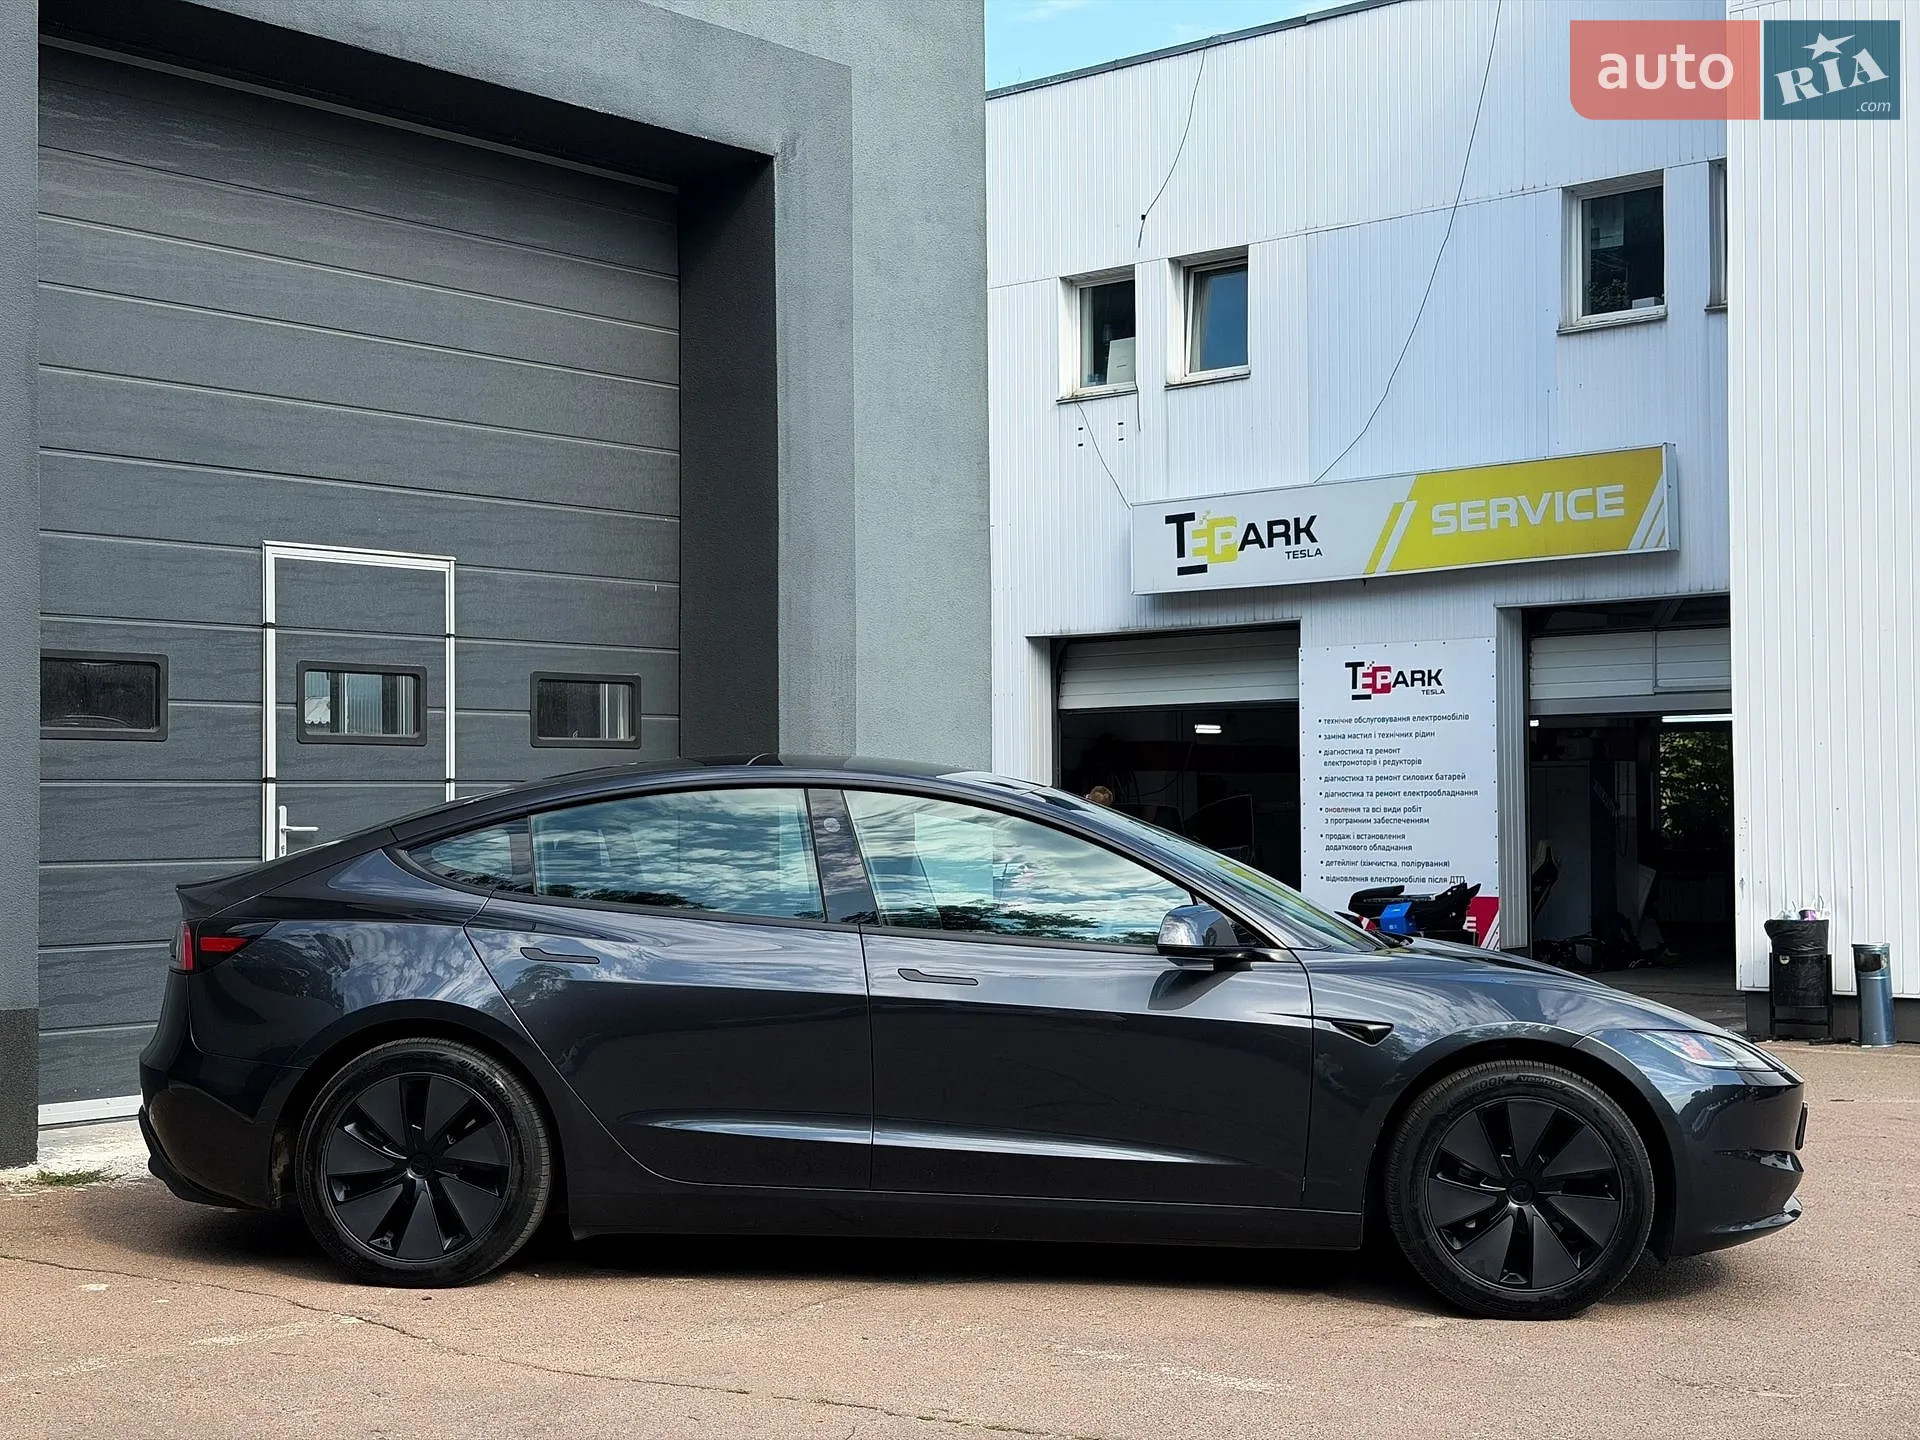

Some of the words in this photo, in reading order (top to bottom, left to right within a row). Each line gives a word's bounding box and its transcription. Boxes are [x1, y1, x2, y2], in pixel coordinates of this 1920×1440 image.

[1431, 484, 1625, 537] SERVICE
[1285, 547, 1323, 561] TESLA
[1354, 715, 1411, 725] обслуговування
[1412, 713, 1470, 723] електромобілів
[1415, 731, 1435, 739] рідин
[1324, 749, 1363, 757] діагностика
[1375, 748, 1400, 756] ремонт
[1324, 758, 1377, 767] електромоторів
[1382, 757, 1422, 766] редукторів
[1324, 775, 1363, 783] діагностика
[1375, 774, 1401, 783] ремонт
[1435, 772, 1466, 781] батарей
[1375, 790, 1401, 798] ремонт
[1403, 789, 1478, 797] електрообладнання
[1383, 806, 1401, 814] види
[1403, 805, 1422, 814] робіт
[1330, 817, 1372, 826] програмним
[1373, 817, 1430, 825] забеспеченням
[1325, 833, 1351, 841] продаж
[1325, 859, 1358, 867] детейлінг
[1370, 875, 1426, 884] електромобілів
[1428, 876, 1447, 884] після
